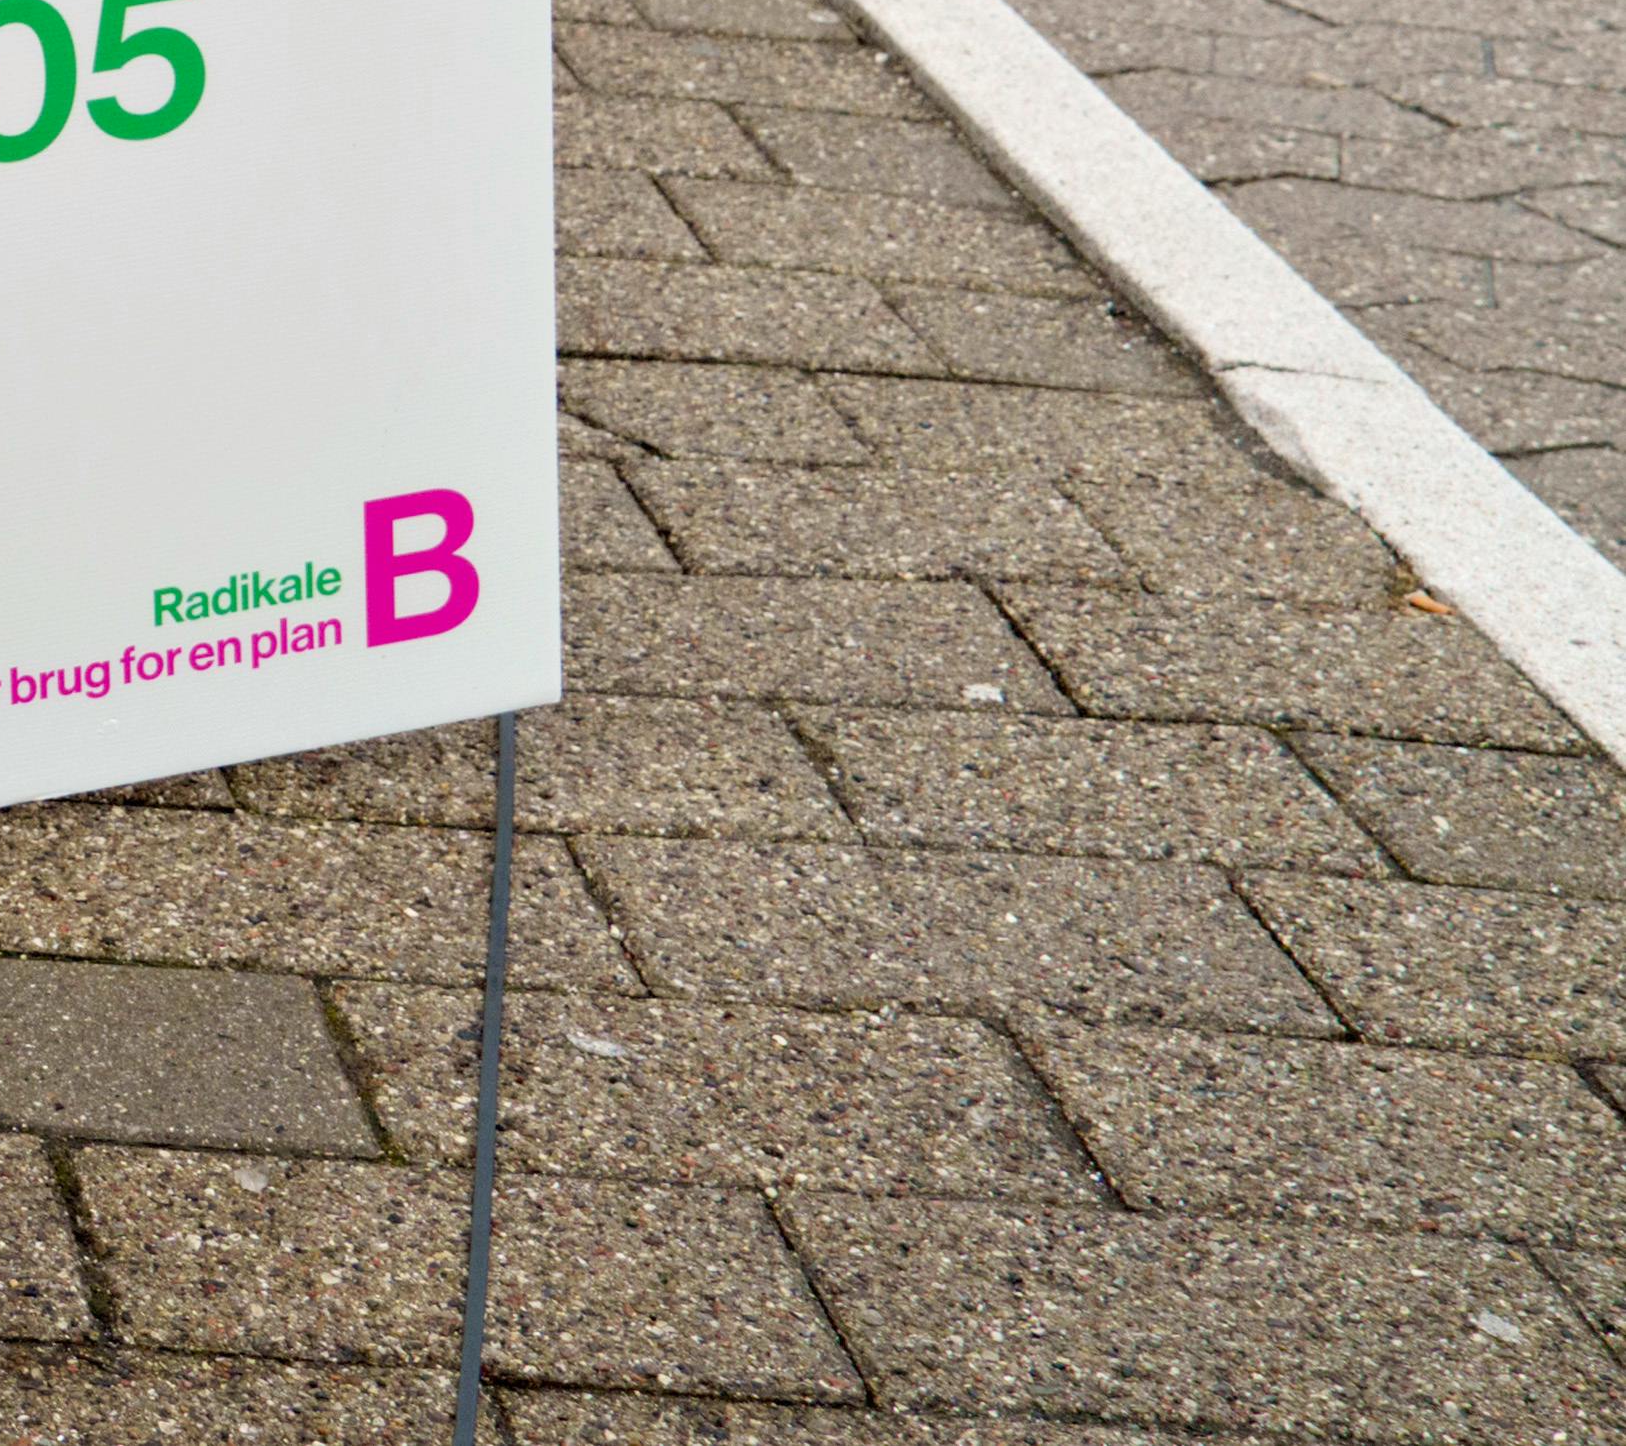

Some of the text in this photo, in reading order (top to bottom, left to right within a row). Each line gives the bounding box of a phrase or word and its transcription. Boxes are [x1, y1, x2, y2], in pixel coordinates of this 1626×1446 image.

[152, 561, 342, 627] Radikale
[363, 488, 481, 649] B
[10, 660, 112, 706] brug
[120, 645, 182, 685] for
[188, 636, 242, 672] en
[251, 617, 343, 670] plan
